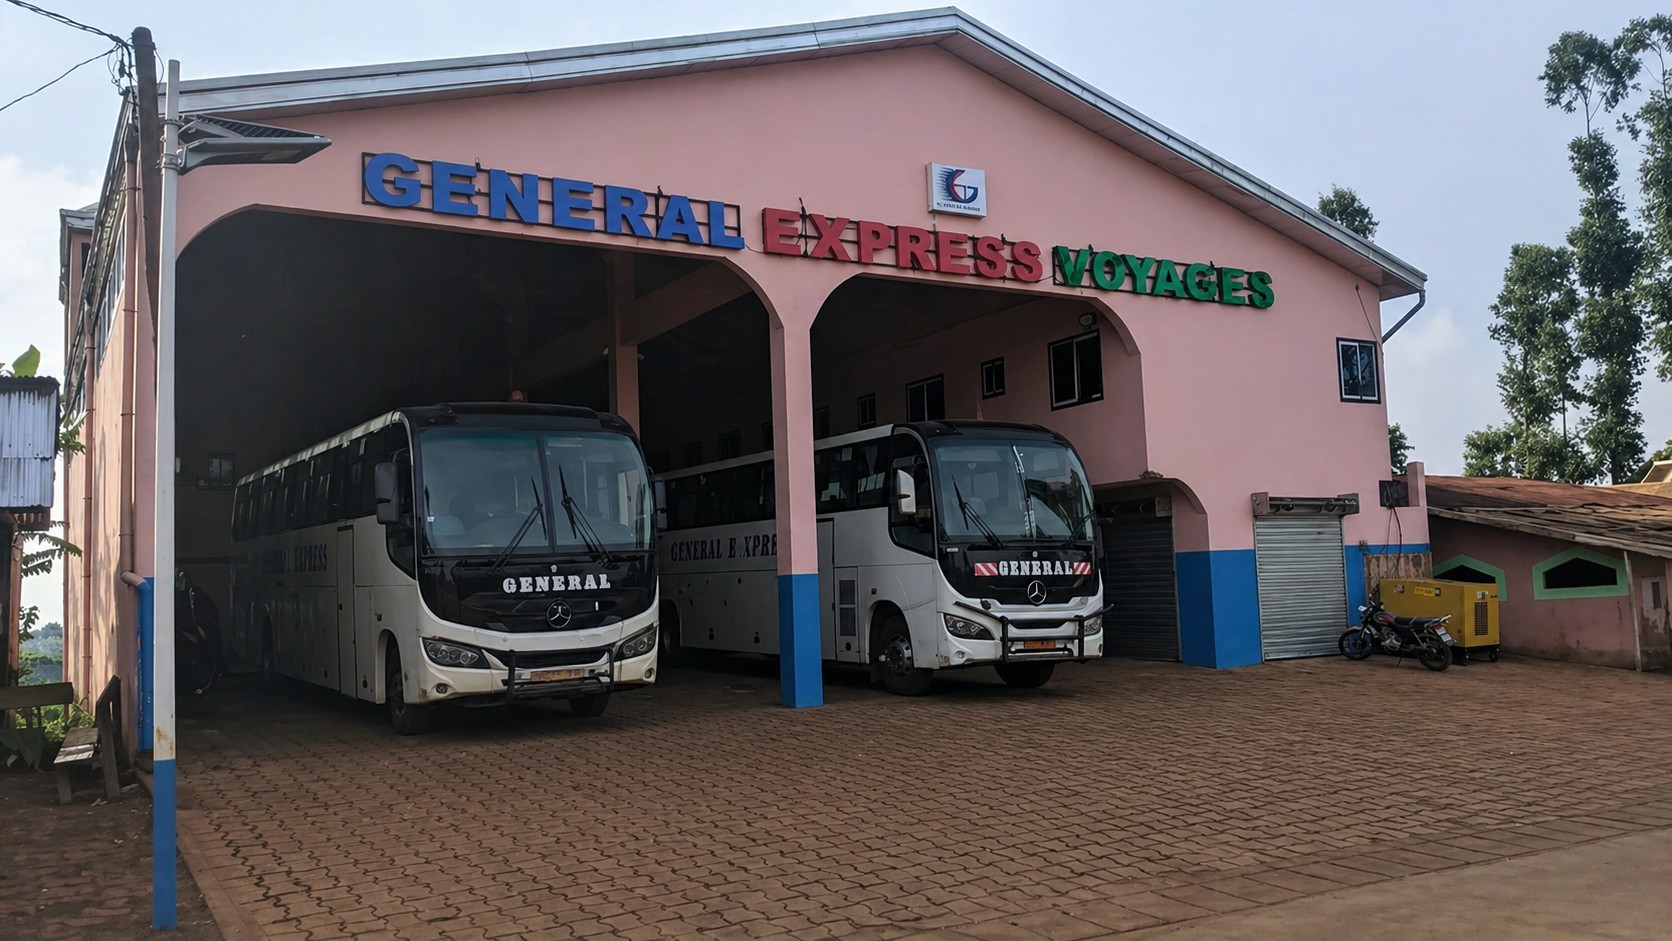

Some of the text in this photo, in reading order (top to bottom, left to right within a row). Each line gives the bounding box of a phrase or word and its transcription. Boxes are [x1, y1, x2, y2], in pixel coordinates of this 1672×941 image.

[364, 152, 1275, 309] GENERAL EXPRESS VOYAGES
[671, 539, 723, 562] GENERAL
[998, 560, 1073, 576] GENERAL
[502, 573, 611, 594] GENERAL
